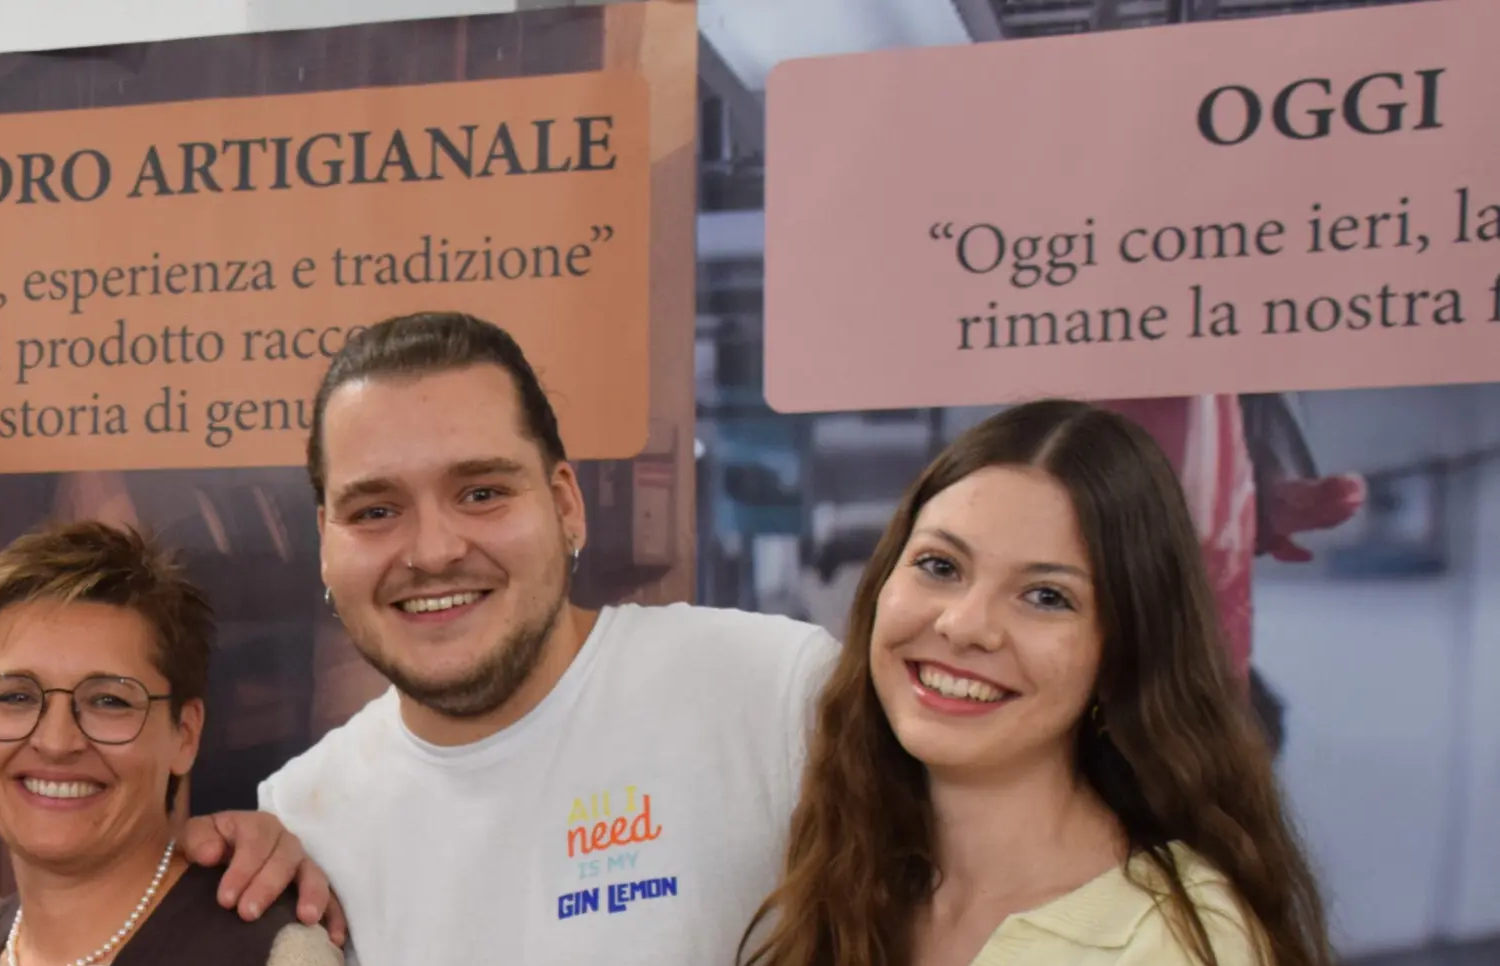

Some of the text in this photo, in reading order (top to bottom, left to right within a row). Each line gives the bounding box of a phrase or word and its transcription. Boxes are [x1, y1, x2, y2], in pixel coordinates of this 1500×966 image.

[1197, 68, 1446, 146] OGGI
[126, 115, 617, 198] ARTIGIANALE
[23, 252, 277, 315] esperienza
[292, 257, 316, 289] e
[332, 224, 615, 287] tradizione”
[930, 218, 1097, 289] “Oggi
[1119, 220, 1285, 264] come
[1307, 196, 1430, 254] ieri,
[957, 301, 1168, 350] rimane
[1188, 284, 1239, 338] la
[1262, 284, 1466, 335] nostra
[15, 316, 226, 385] prodotto
[144, 385, 190, 434] di
[204, 398, 312, 448] genu
[567, 794, 663, 859] need
[624, 784, 638, 813] I
[577, 851, 638, 880] IS MY
[558, 886, 600, 920] GIN
